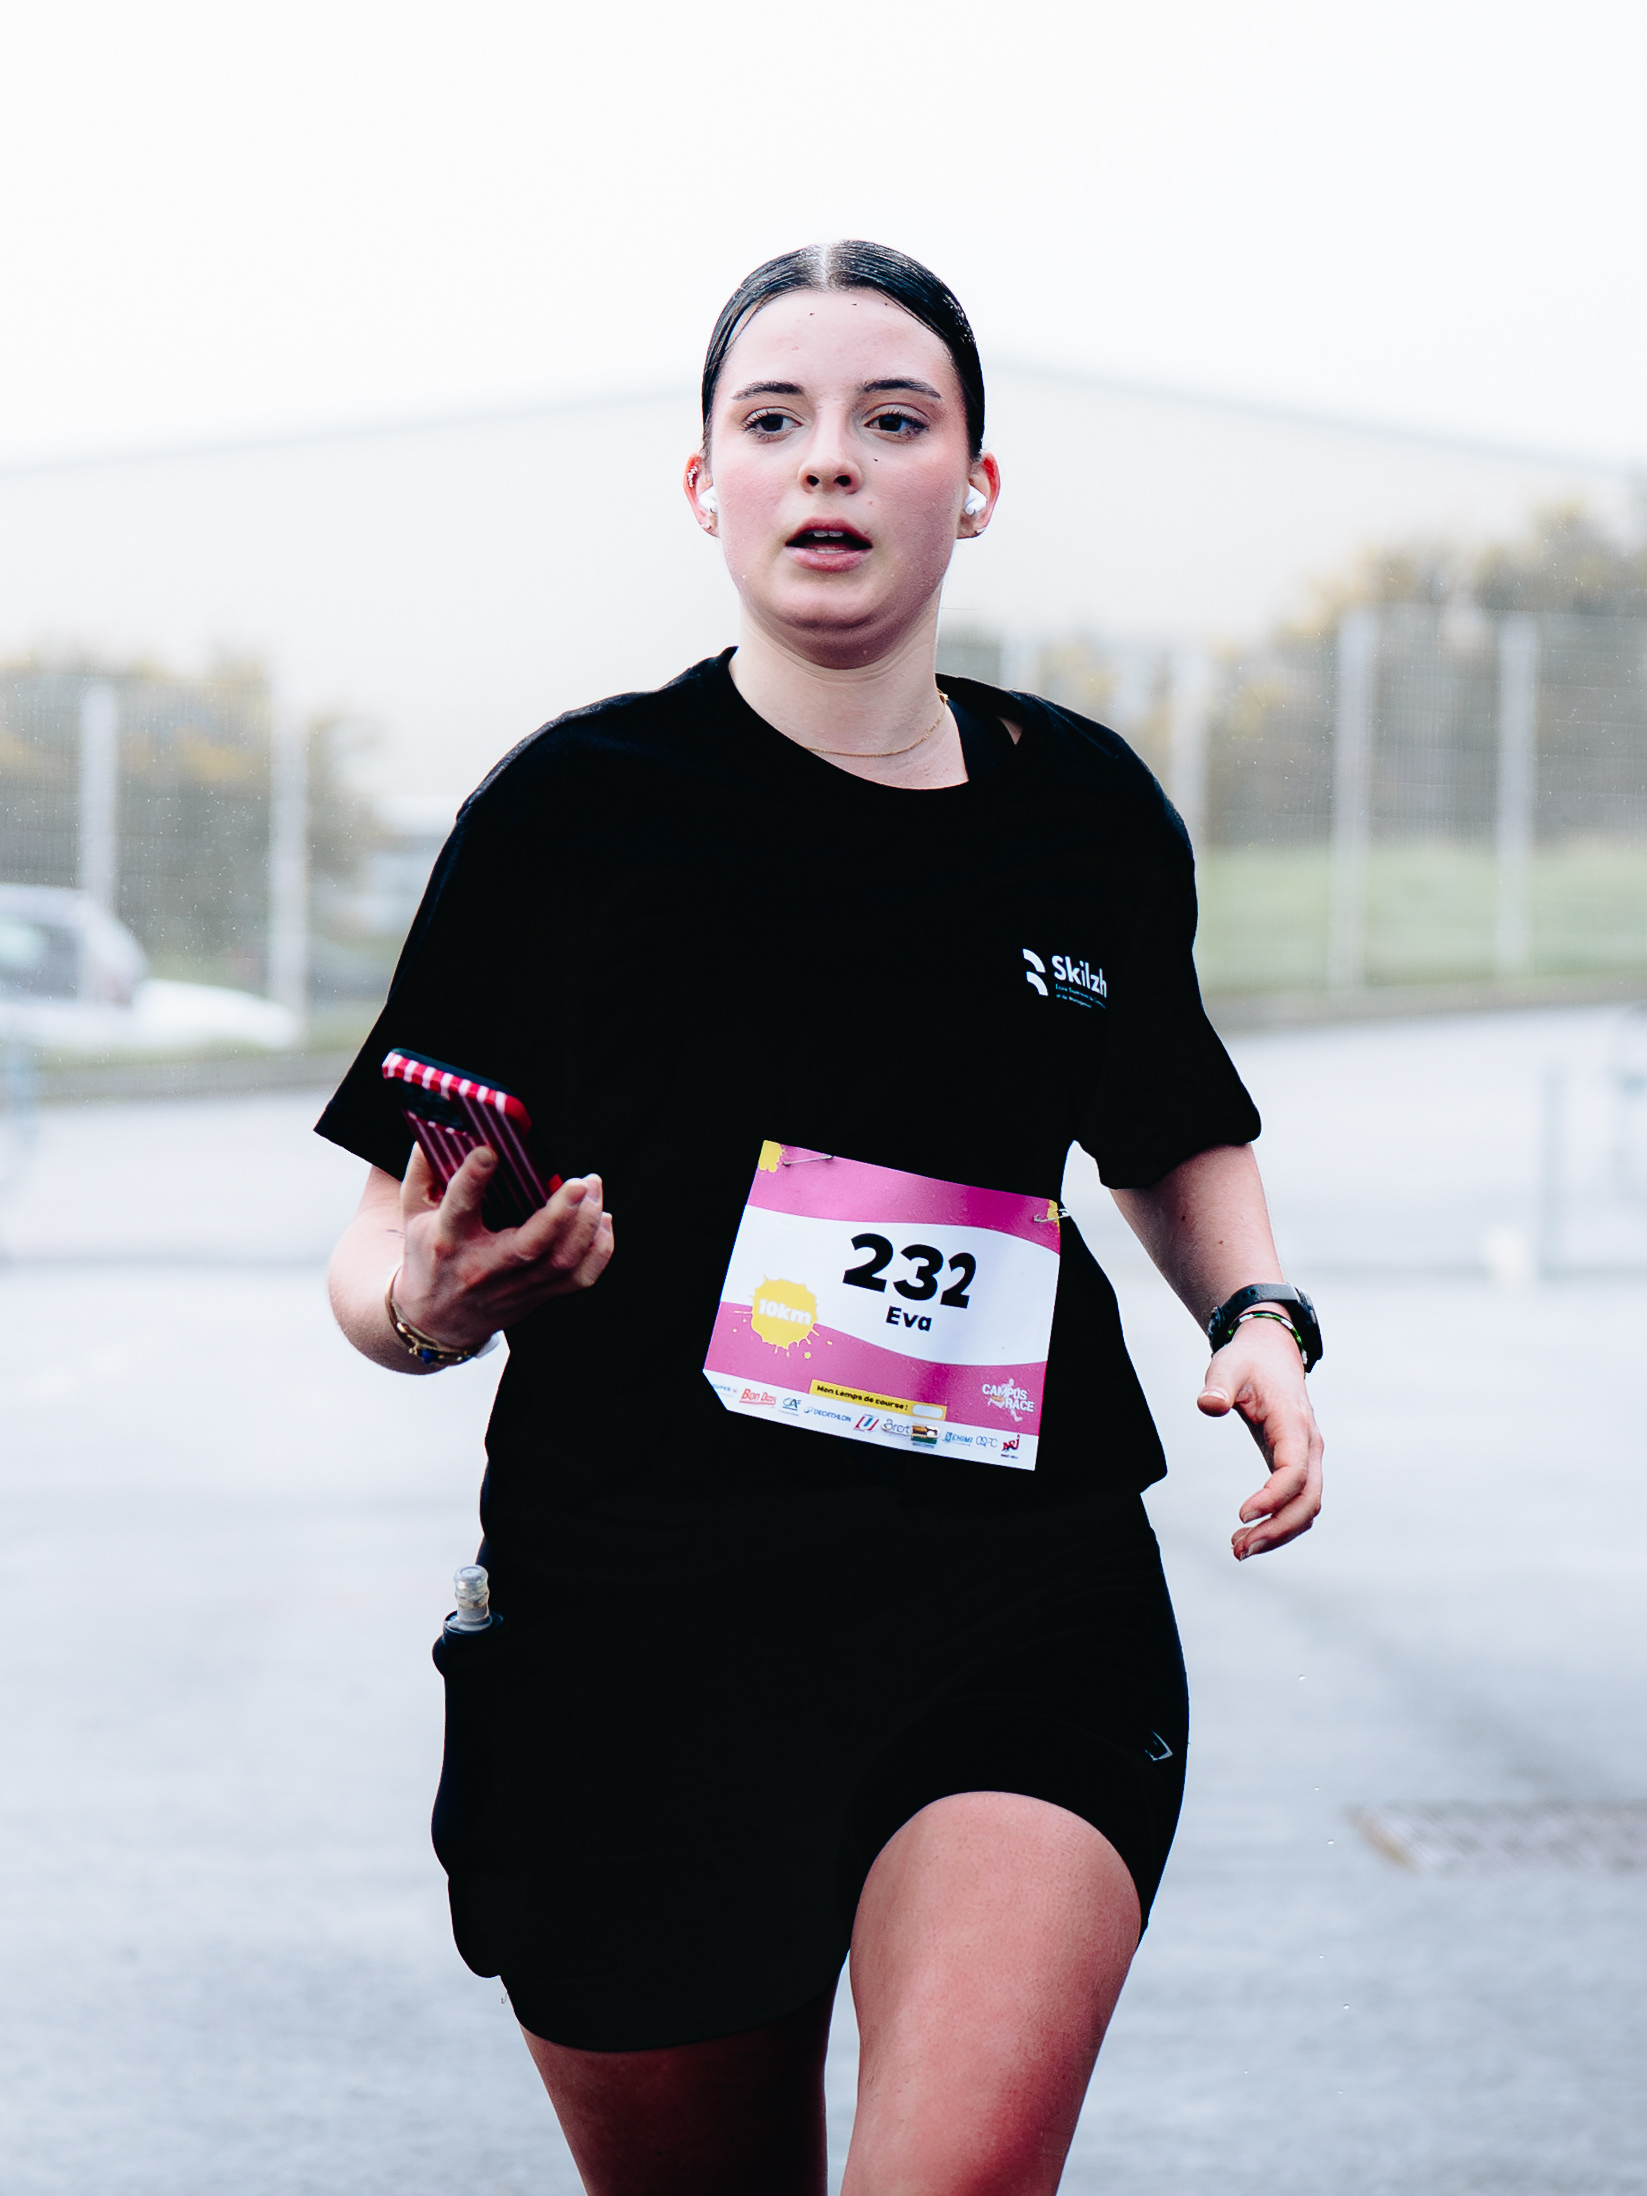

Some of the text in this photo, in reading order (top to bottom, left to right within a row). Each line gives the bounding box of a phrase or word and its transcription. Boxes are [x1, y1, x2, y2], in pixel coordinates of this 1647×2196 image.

[1051, 955, 1107, 998] Skilzh
[842, 1232, 977, 1309] 232
[758, 1298, 812, 1326] 10km
[885, 1305, 932, 1332] Eva
[863, 1395, 874, 1404] de
[982, 1383, 1028, 1400] CAMPUS
[1004, 1397, 1035, 1413] RACE
